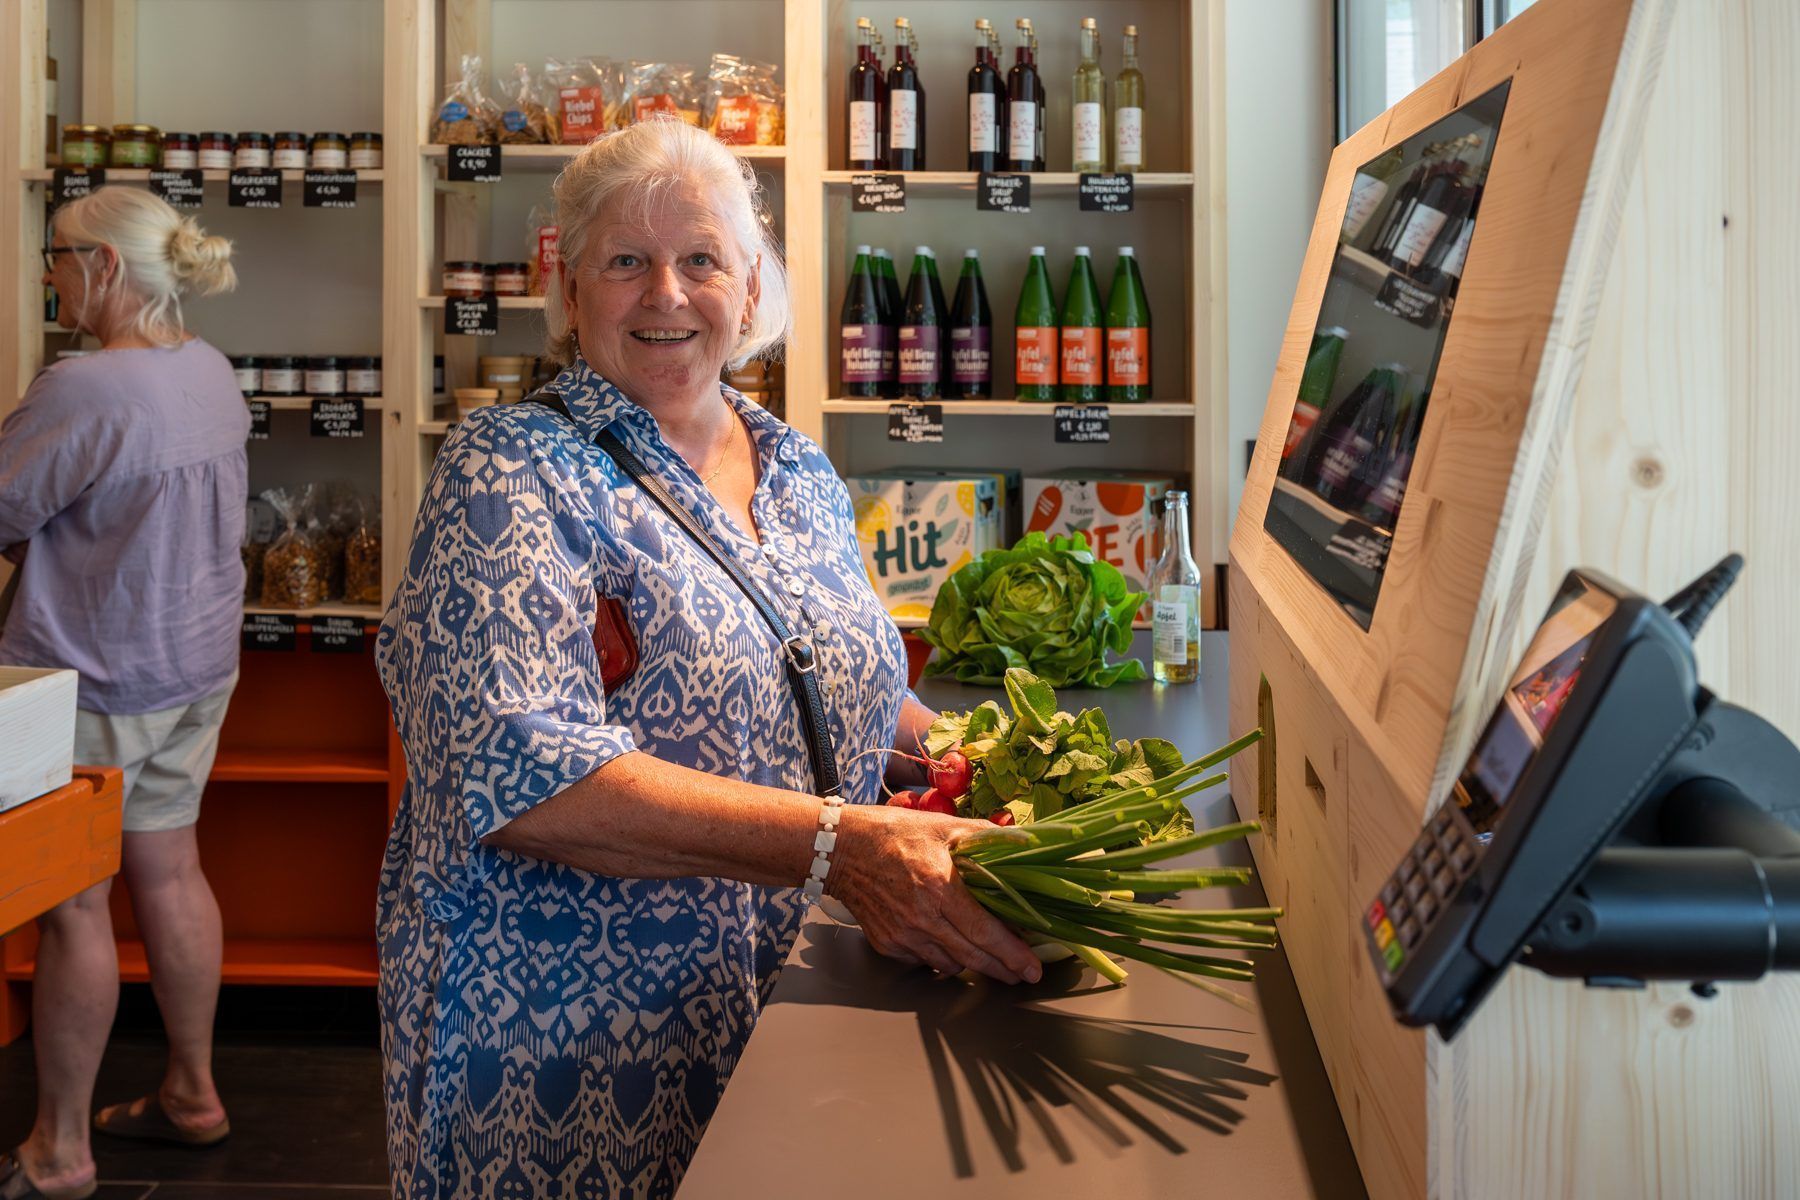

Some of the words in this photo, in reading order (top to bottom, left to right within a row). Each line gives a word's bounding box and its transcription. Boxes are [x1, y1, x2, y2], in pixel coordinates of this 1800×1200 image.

[566, 112, 593, 127] Chips
[1069, 504, 1094, 516] Egger
[873, 520, 948, 577] Hit
[1156, 610, 1177, 622] Apfel
